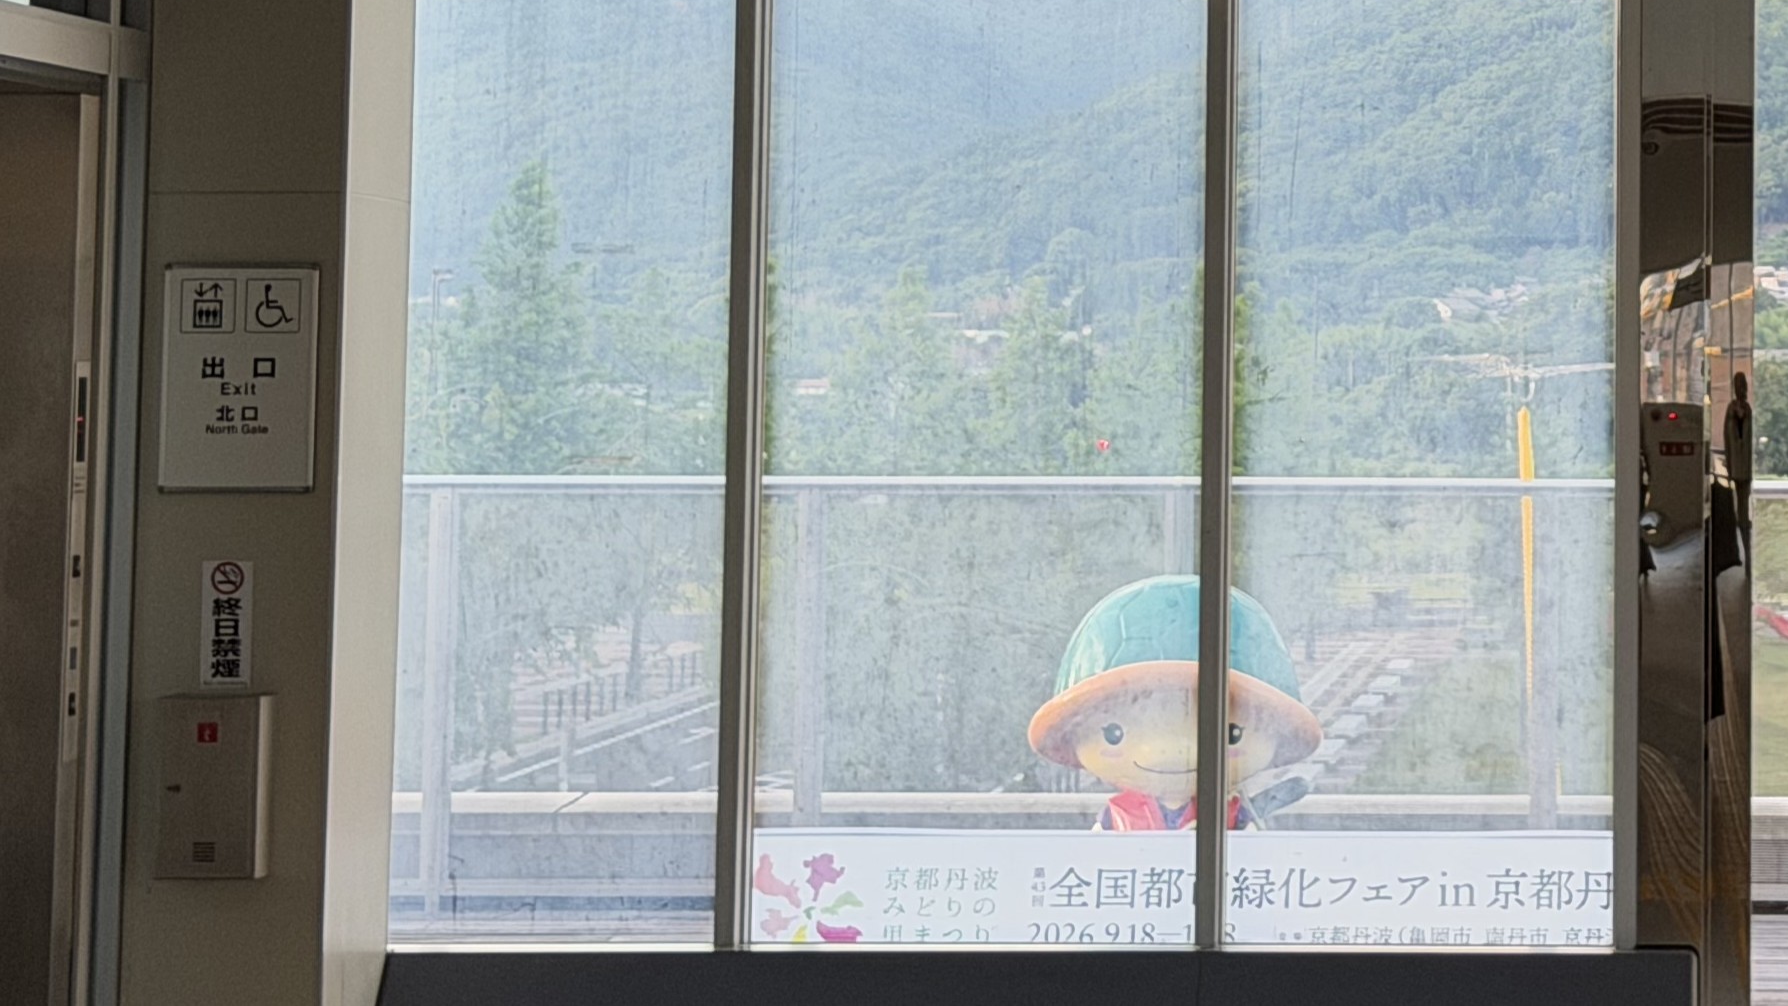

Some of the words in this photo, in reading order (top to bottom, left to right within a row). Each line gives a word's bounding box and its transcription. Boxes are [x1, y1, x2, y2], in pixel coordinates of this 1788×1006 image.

[201, 356, 276, 379] 出口
[220, 382, 257, 396] Exit
[215, 404, 259, 422] 北口
[205, 424, 238, 435] North
[241, 424, 269, 435] Gate
[210, 596, 242, 679] 終日禁煙
[883, 866, 1001, 893] 京都丹波
[881, 895, 998, 918] みどりの
